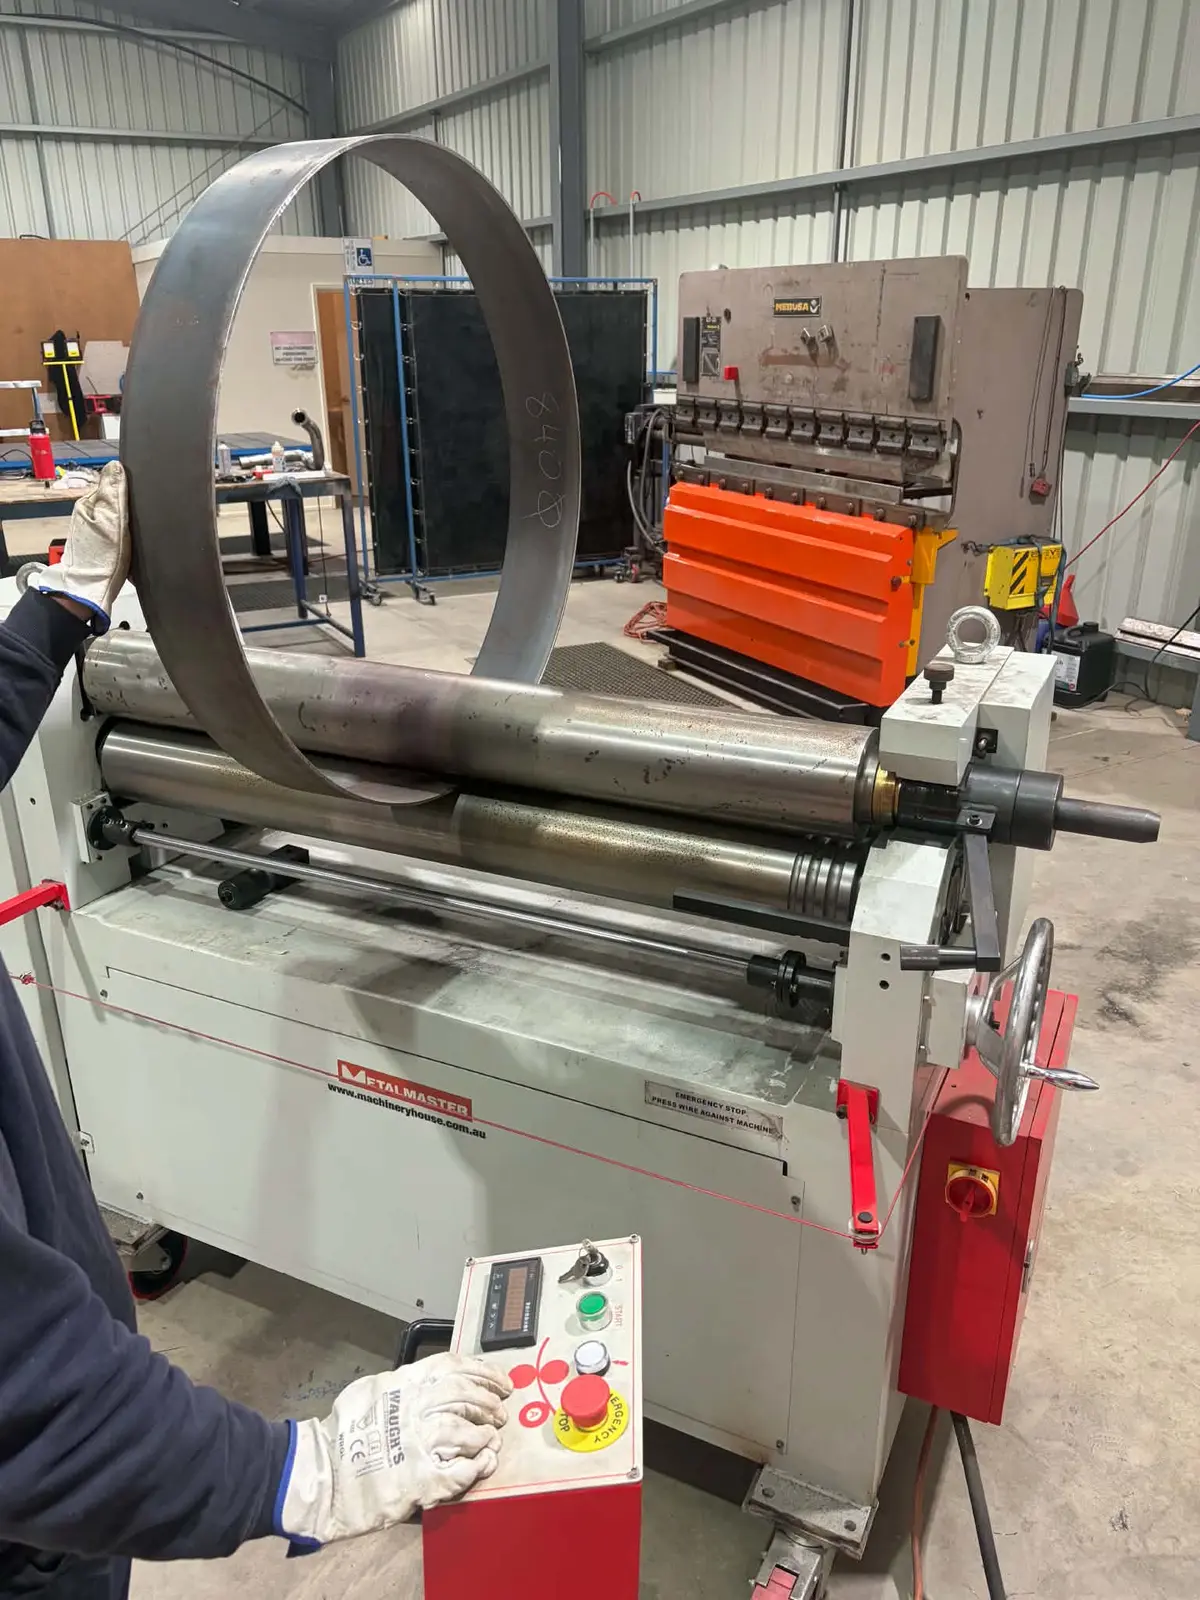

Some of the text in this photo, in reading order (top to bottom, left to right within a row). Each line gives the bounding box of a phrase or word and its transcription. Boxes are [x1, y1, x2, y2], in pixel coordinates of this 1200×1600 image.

[327, 1082, 487, 1140] www.machineryhouse.com.au
[341, 1063, 469, 1117] METALMASTER
[651, 1096, 677, 1108] PRESS
[678, 1103, 699, 1115] WIRE
[700, 1108, 735, 1124] AGAINST
[675, 1091, 747, 1116] EMERGENCY STOP
[389, 1389, 405, 1465] WAUGH'S
[558, 1412, 571, 1432] TOP
[594, 1393, 624, 1443] ERGENCY
